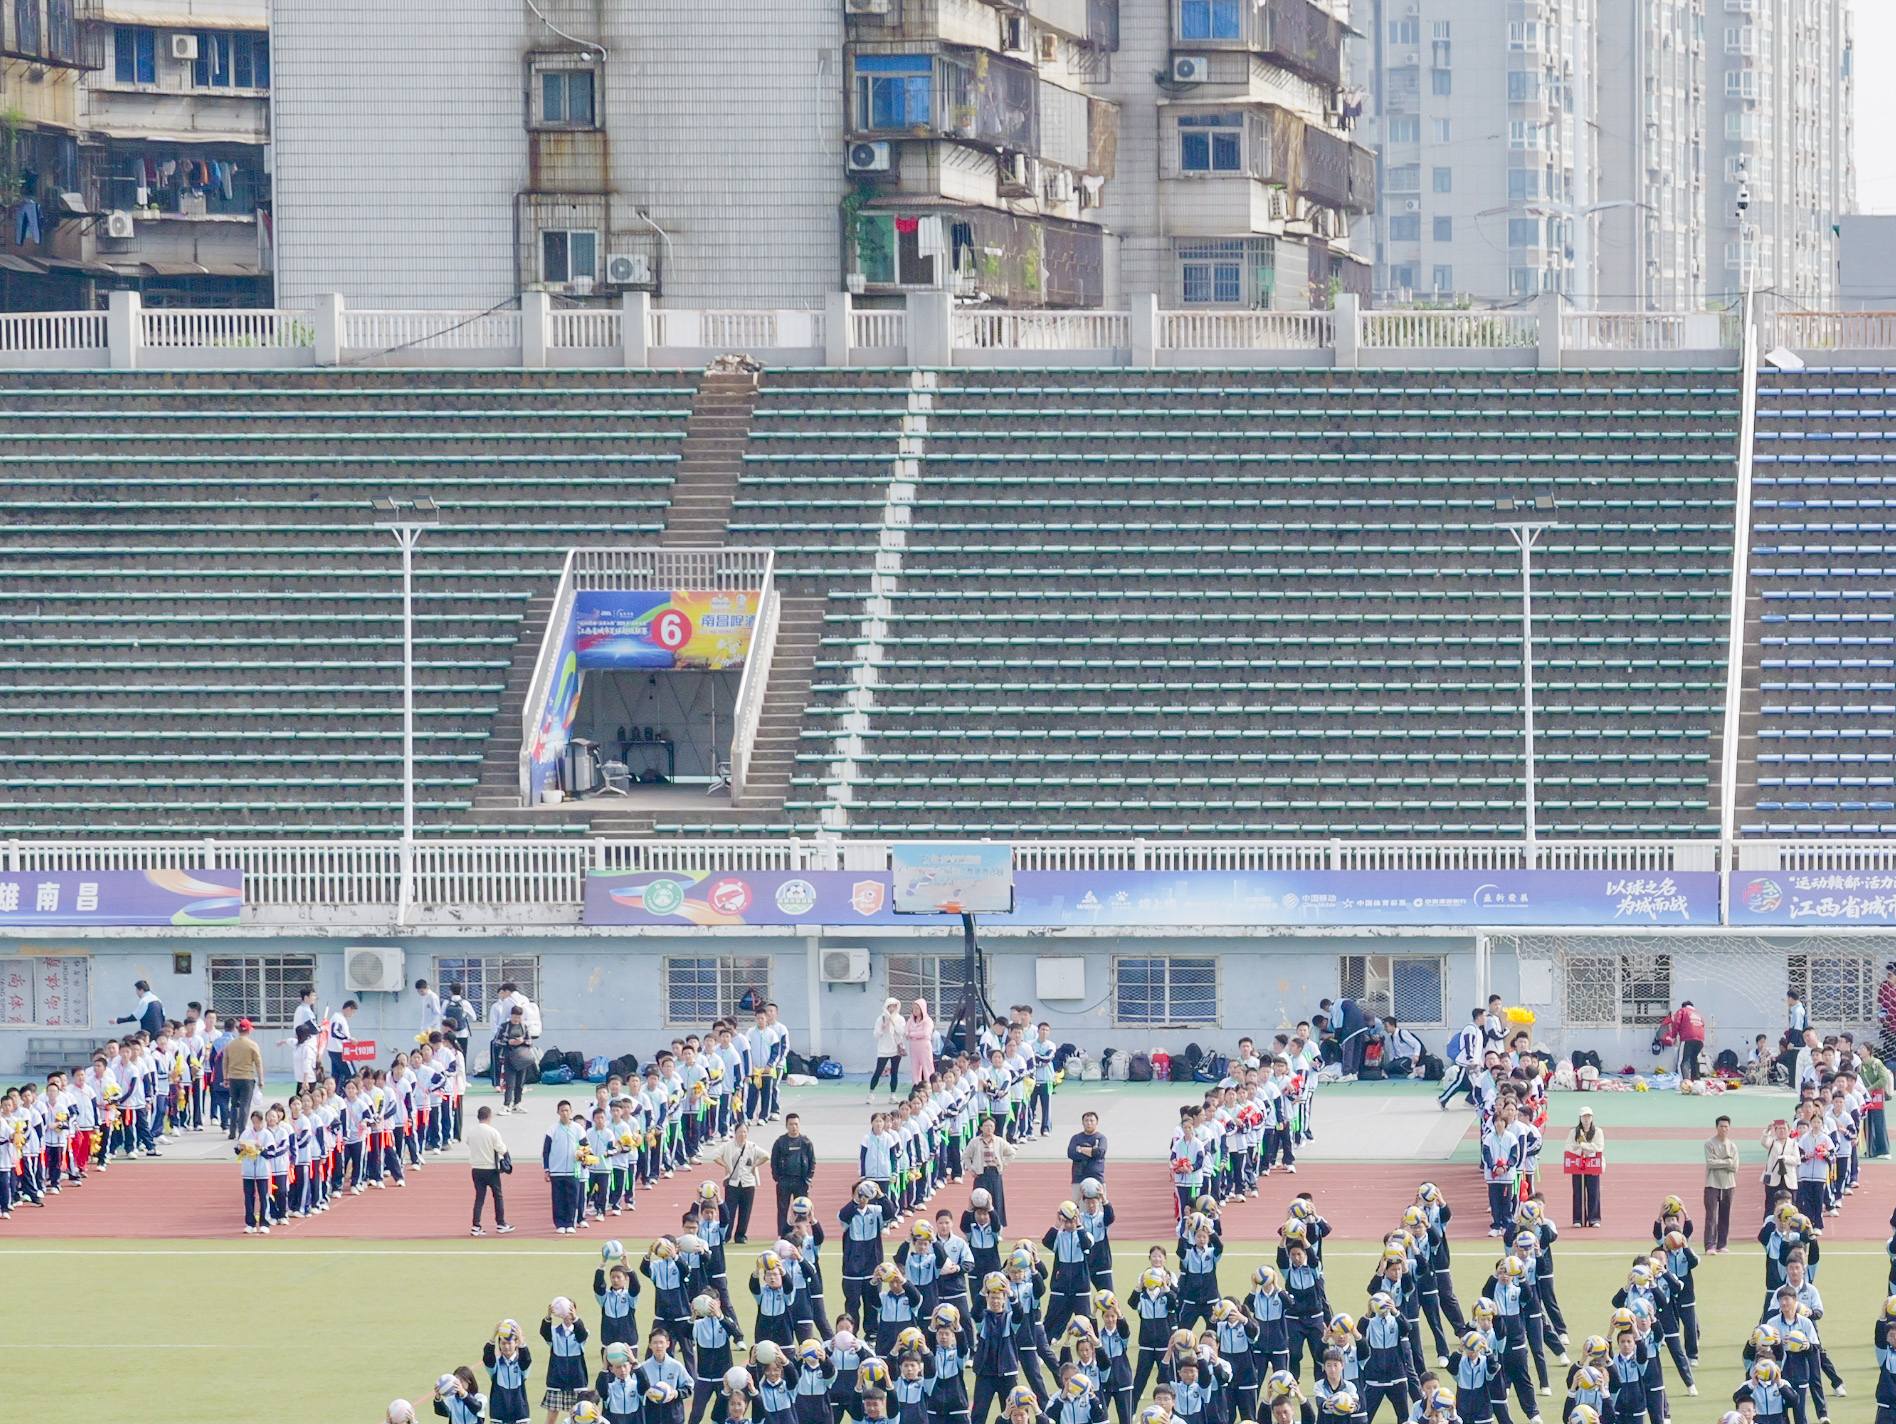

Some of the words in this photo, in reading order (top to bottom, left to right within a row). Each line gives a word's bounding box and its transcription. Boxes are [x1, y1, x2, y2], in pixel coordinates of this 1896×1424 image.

[660, 614, 682, 647] 6
[1606, 877, 1677, 897] 以球之名
[1613, 896, 1690, 920] 为城而战
